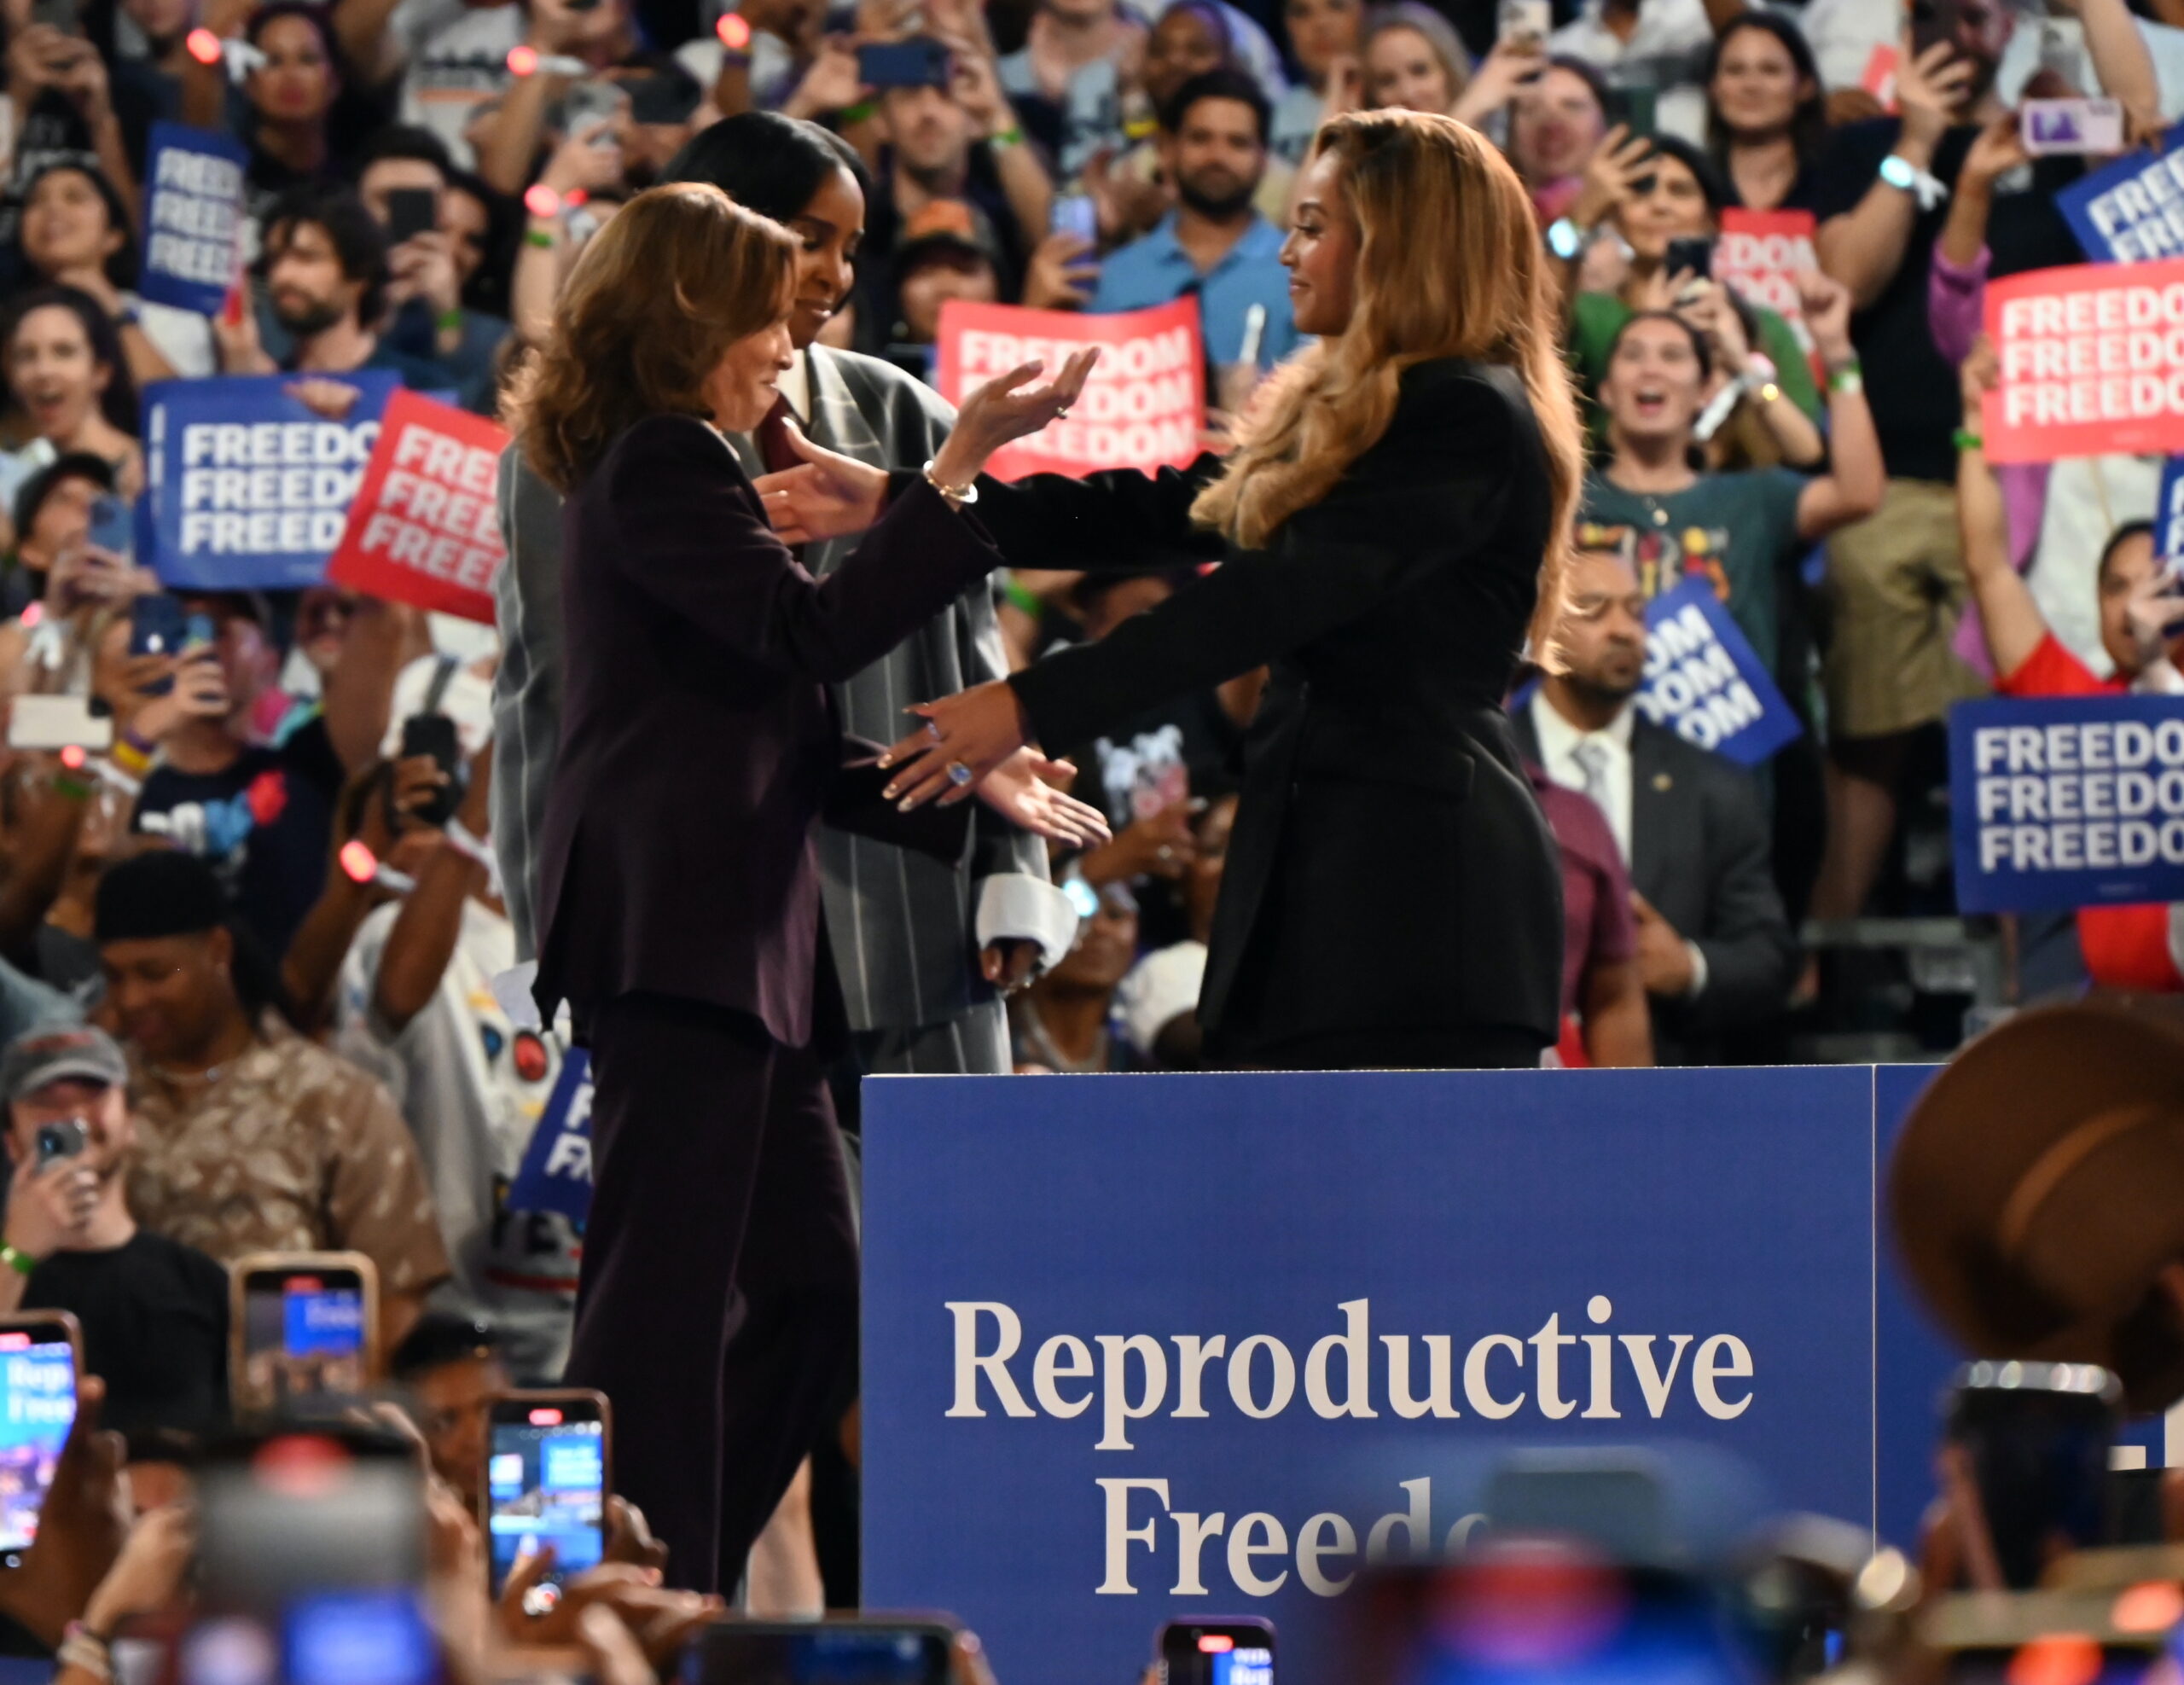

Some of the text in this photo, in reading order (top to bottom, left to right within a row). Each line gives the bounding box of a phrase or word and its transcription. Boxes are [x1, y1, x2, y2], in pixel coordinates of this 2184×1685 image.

[1975, 718, 2184, 773] FREEDO
[1978, 769, 2184, 823] FREEDO
[1980, 818, 2184, 874] FREEDO
[944, 1295, 1754, 1450] Reproductive
